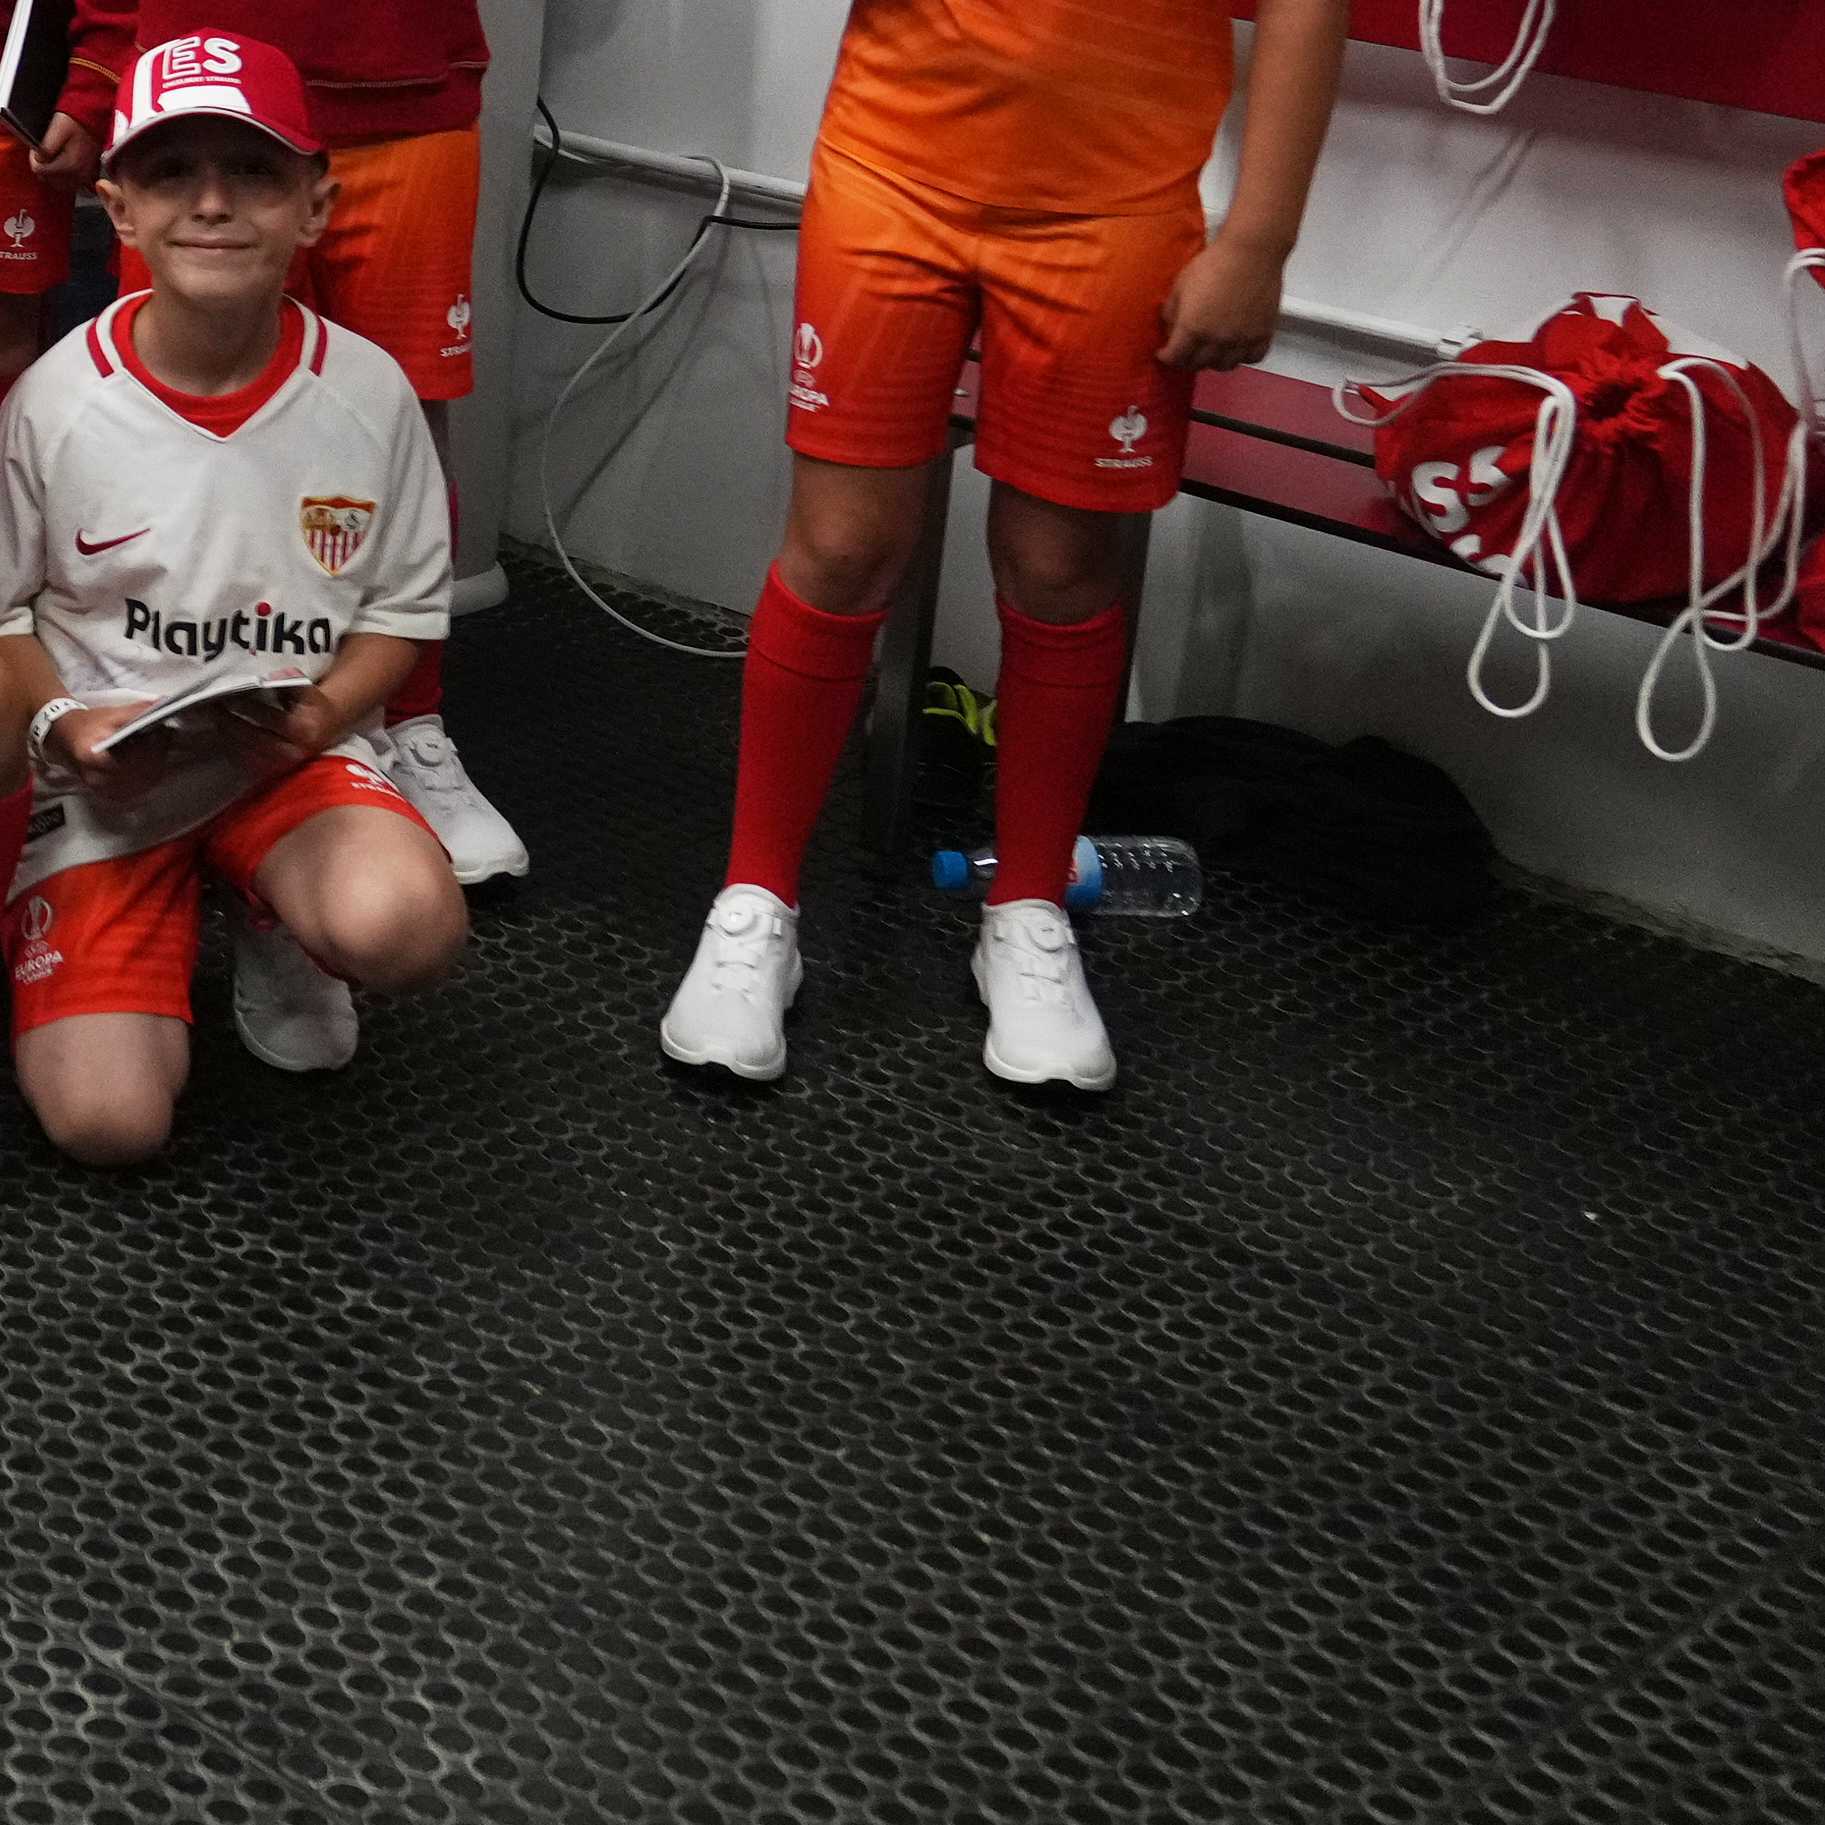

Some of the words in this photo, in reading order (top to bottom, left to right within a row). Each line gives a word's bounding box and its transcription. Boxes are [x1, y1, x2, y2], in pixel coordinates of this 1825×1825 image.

[162, 36, 243, 80] ES
[124, 597, 332, 663] Playtika
[14, 949, 64, 981] EUROPA
